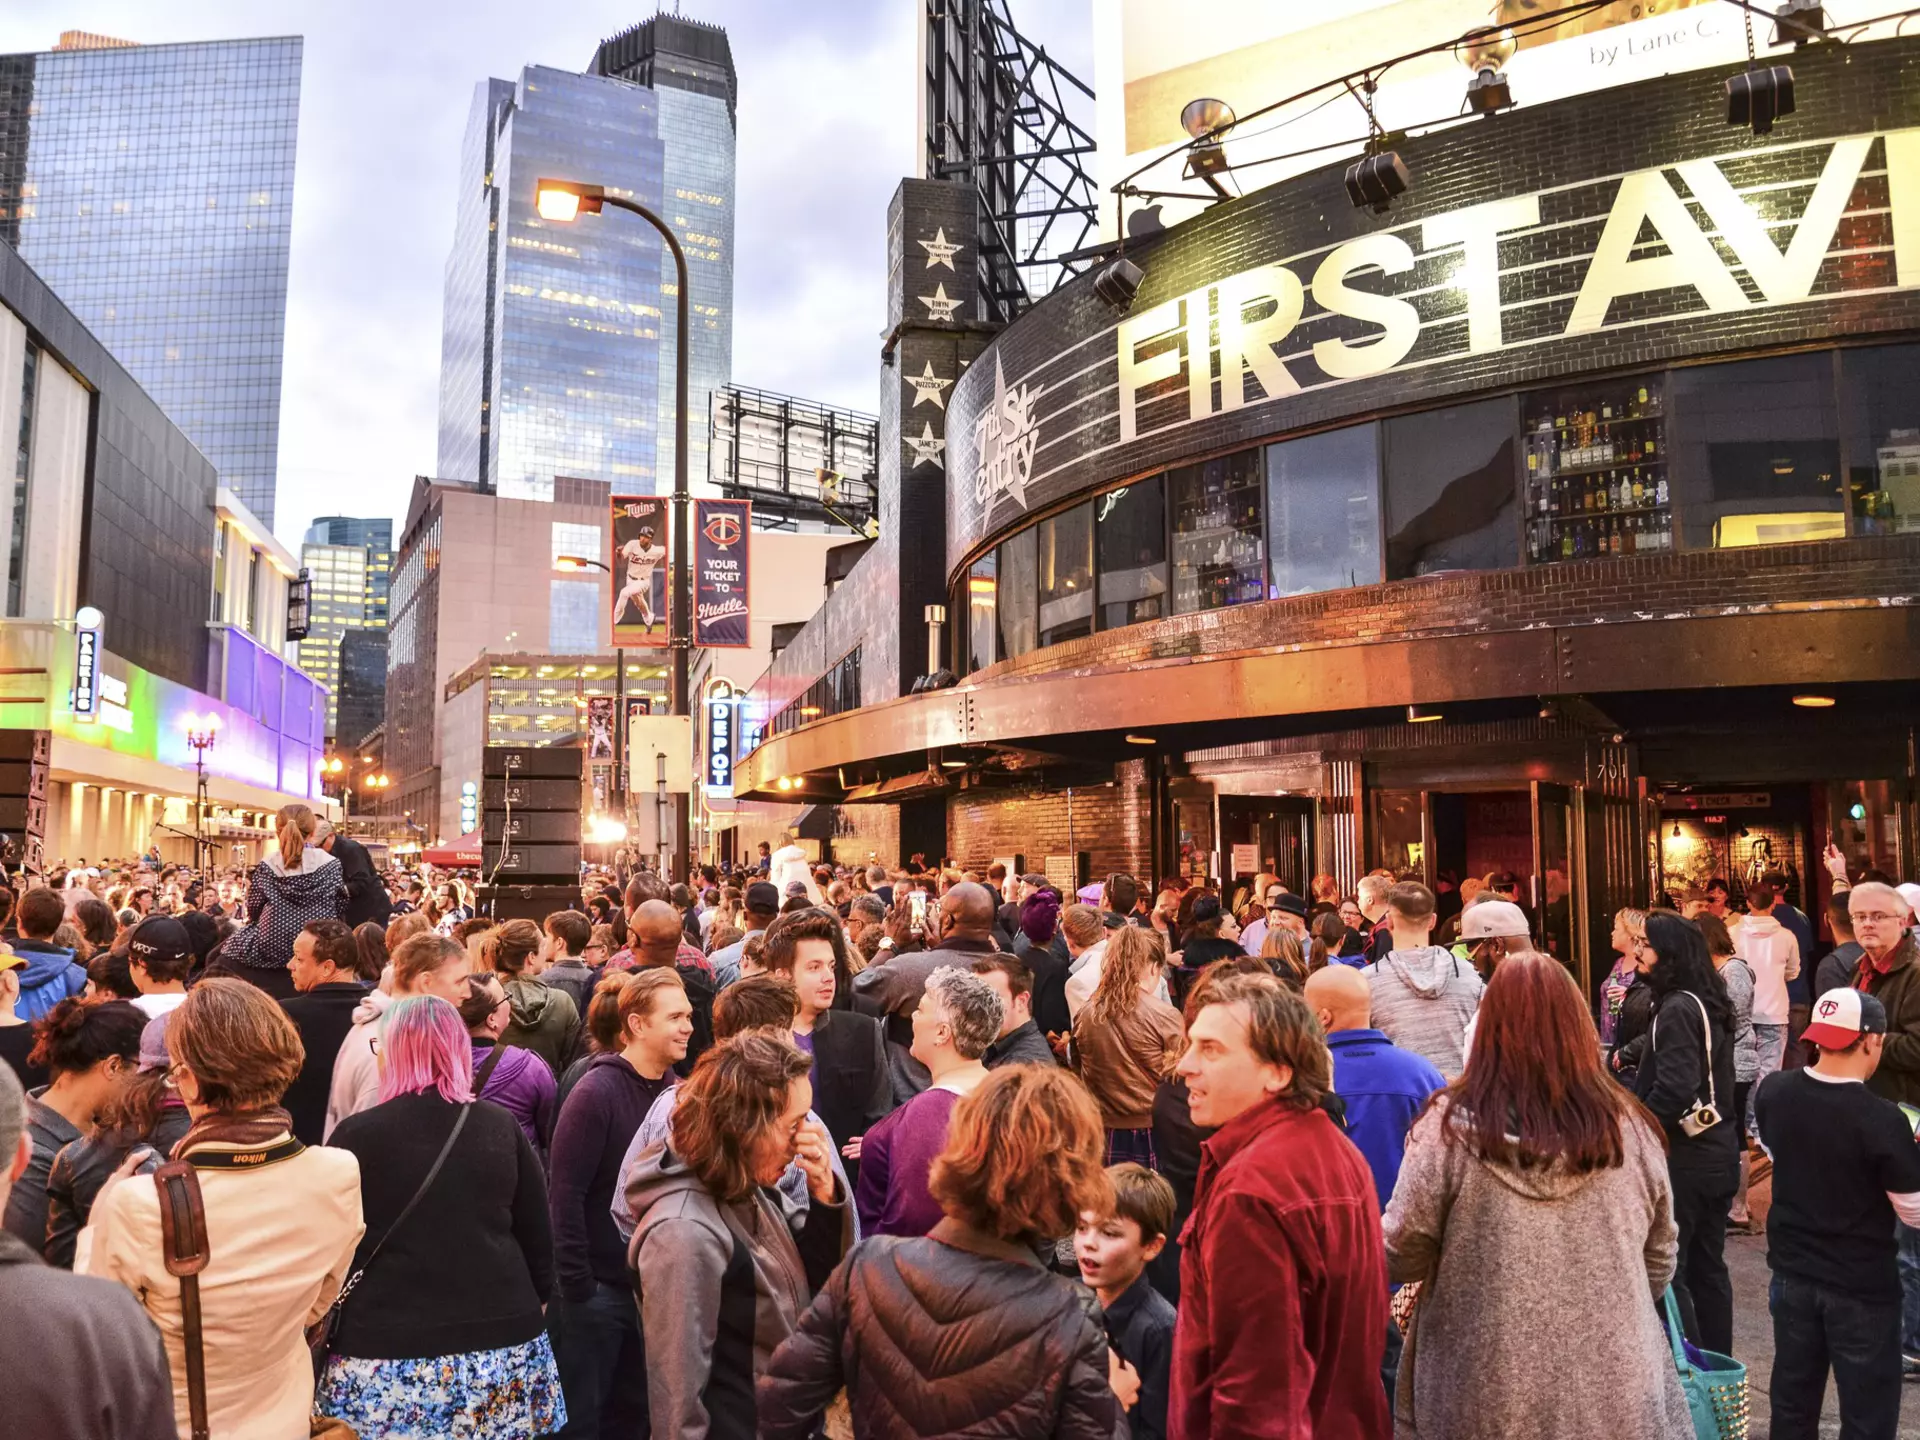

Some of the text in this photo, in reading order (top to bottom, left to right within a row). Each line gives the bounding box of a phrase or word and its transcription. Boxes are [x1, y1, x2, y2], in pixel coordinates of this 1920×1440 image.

[1590, 19, 1720, 66] by Lane C.
[1117, 195, 1541, 443] FIRST
[915, 380, 945, 389] BUZZCOCKS
[1000, 382, 1036, 445] St
[918, 439, 938, 449] JANE'S
[975, 428, 1040, 505] entry
[624, 501, 656, 518] Twins
[706, 558, 738, 570] YOUR
[703, 570, 741, 582] TICKET
[715, 582, 730, 593] TO
[696, 598, 748, 622] Hustle
[77, 632, 94, 710] PARKING
[711, 702, 729, 786] DEPOT
[1597, 763, 1627, 779] 701
[232, 1152, 267, 1164] Nikon
